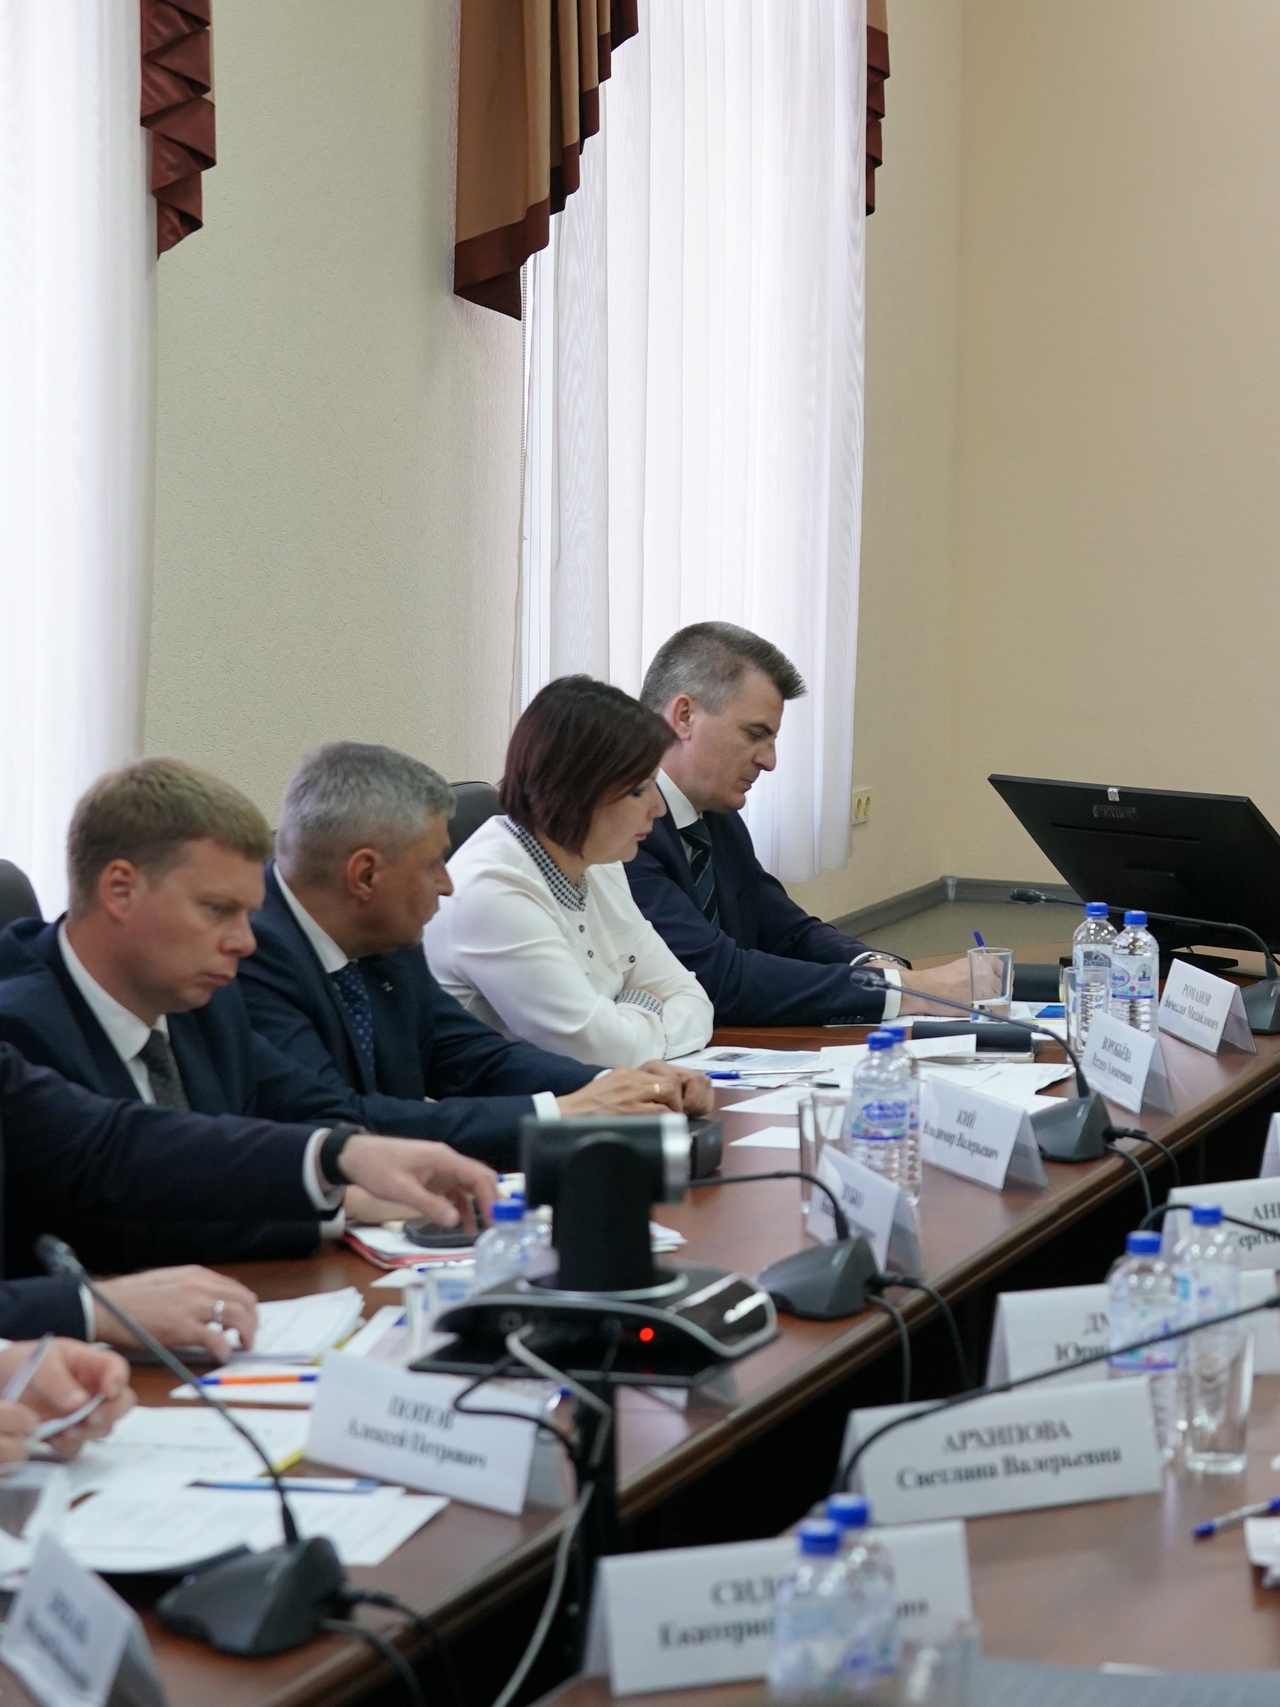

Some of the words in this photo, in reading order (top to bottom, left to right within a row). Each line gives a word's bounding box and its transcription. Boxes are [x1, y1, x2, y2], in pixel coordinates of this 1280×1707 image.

[1181, 983, 1212, 1007] РОМАНОВ
[942, 1417, 1073, 1454] АРХИПОВА
[896, 1460, 999, 1490] Светлана
[1000, 1446, 1123, 1478] Валерьевна
